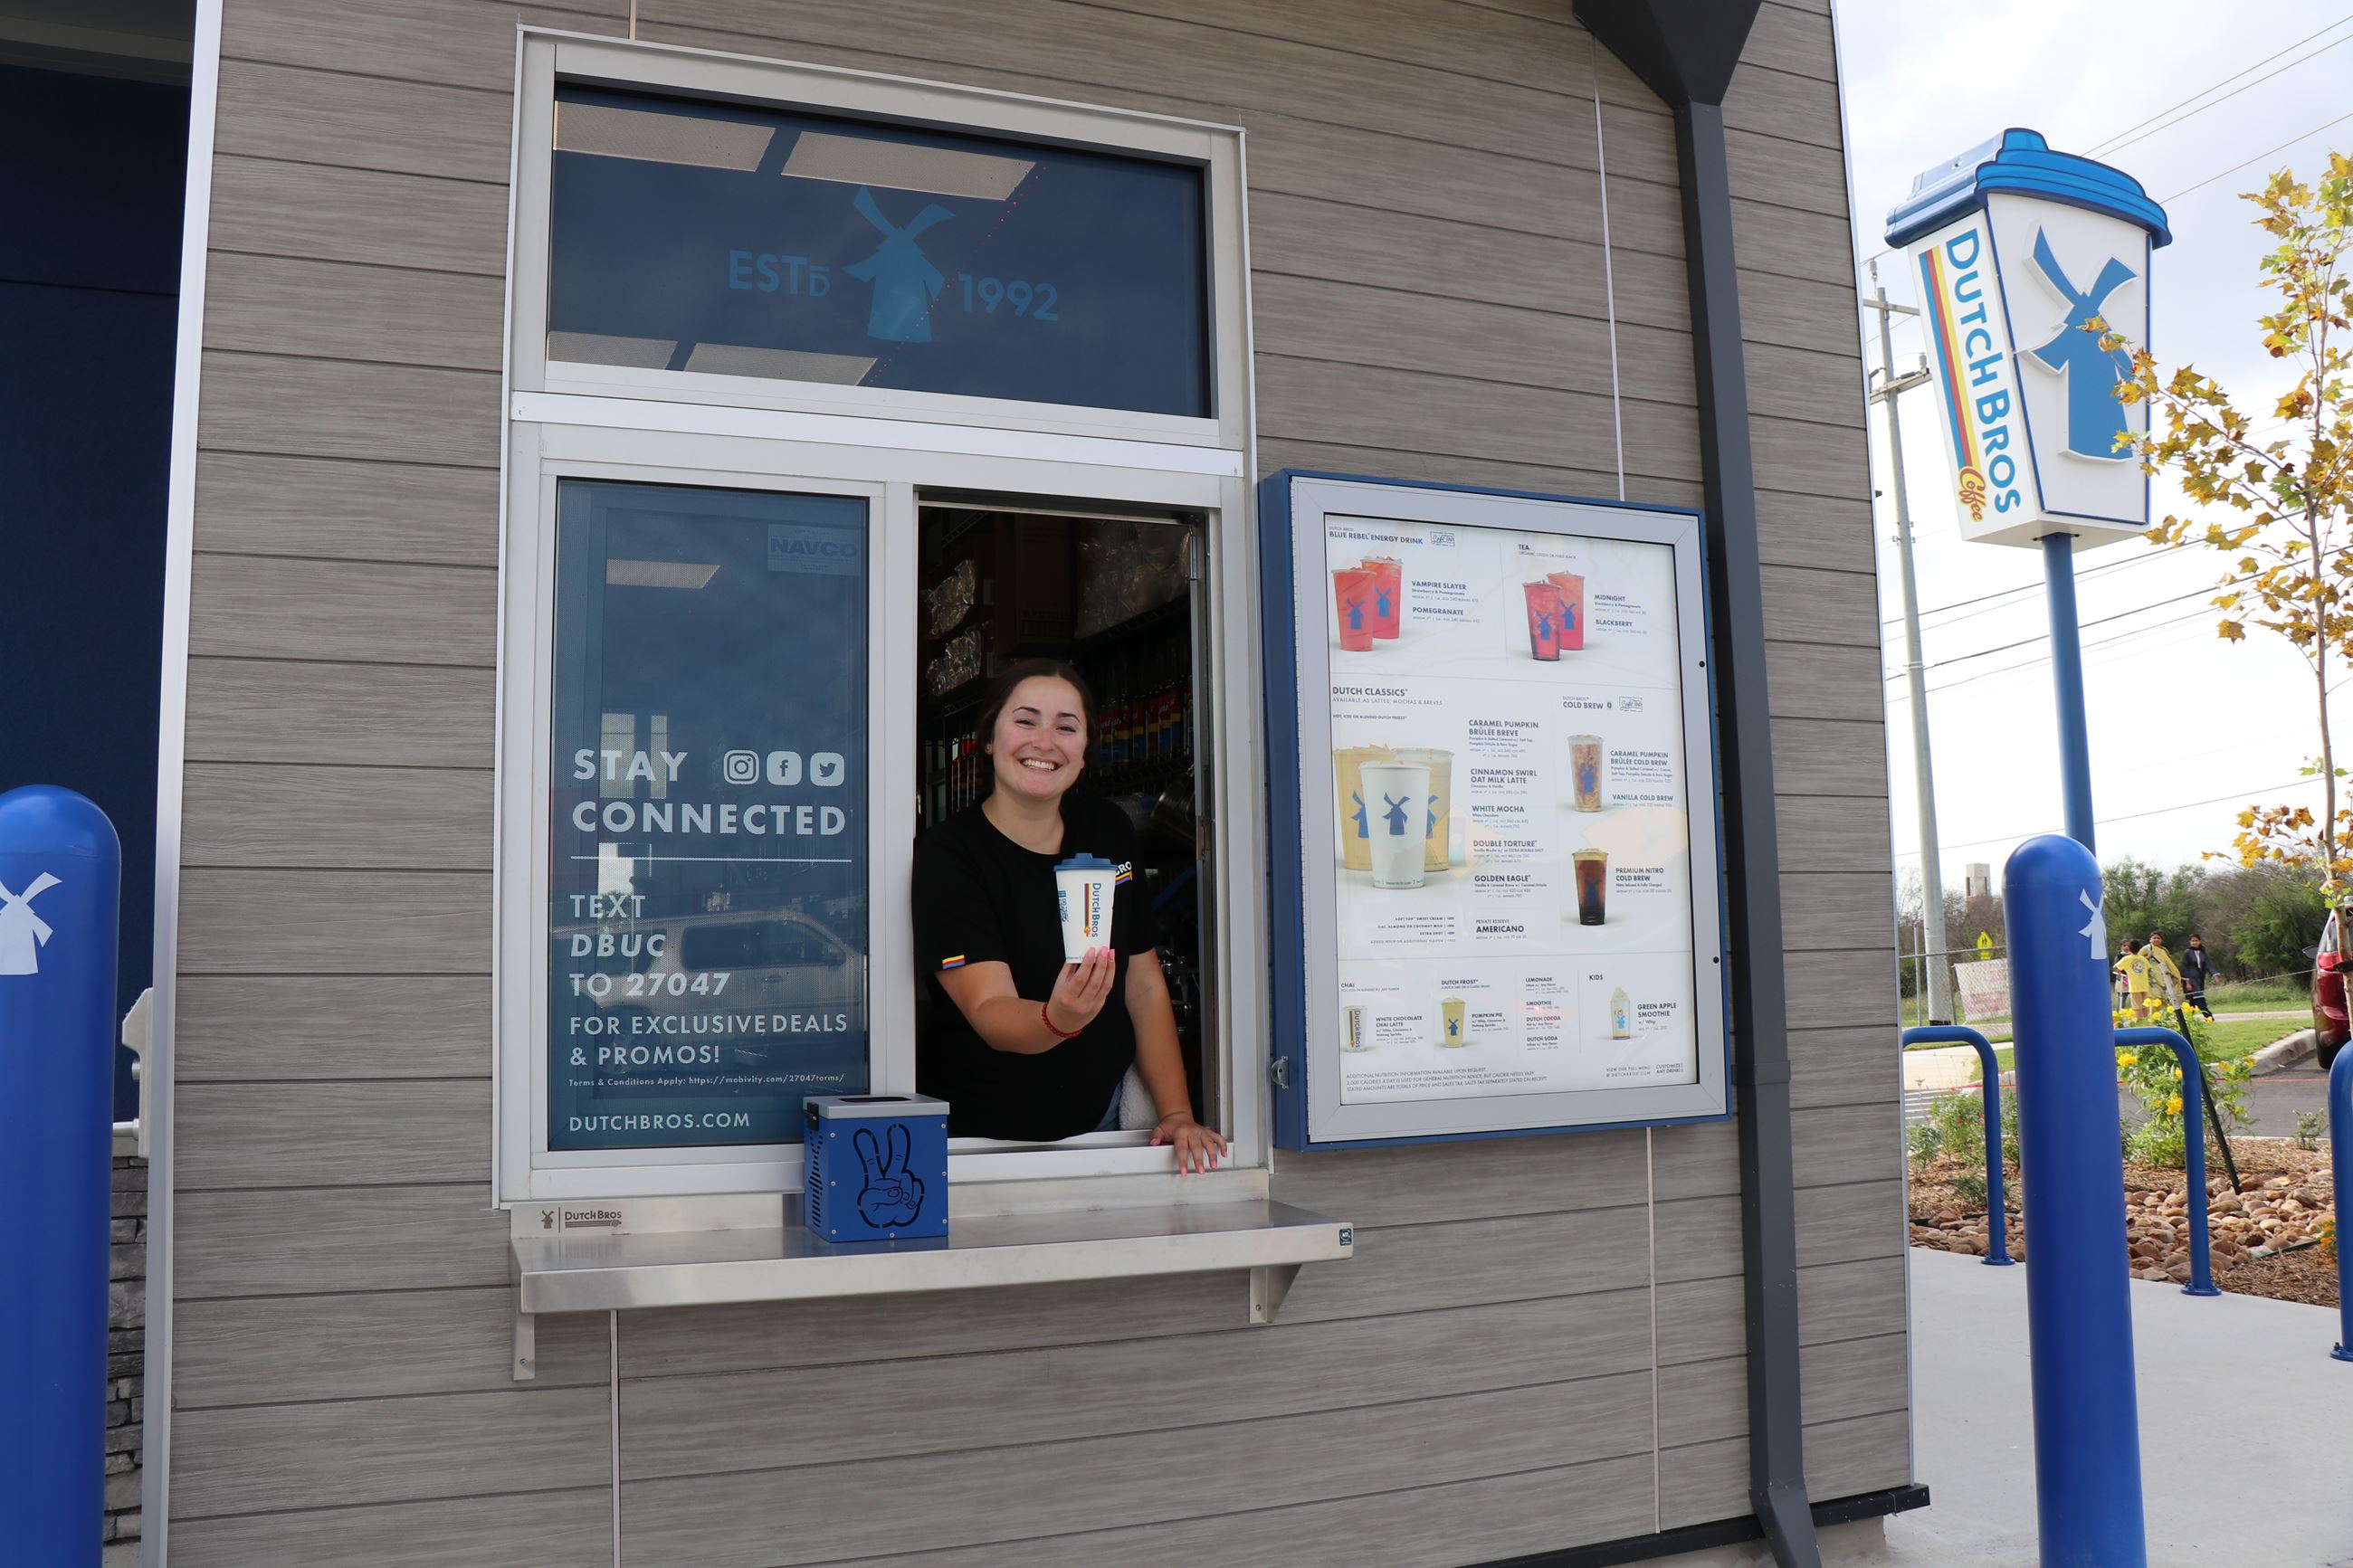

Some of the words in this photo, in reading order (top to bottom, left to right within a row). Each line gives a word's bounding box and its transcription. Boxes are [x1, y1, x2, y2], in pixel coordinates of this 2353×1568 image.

[958, 274, 1057, 321] 1992
[1958, 466, 1986, 522] Coffee
[770, 538, 858, 557] NAVCO
[1348, 532, 1368, 540] REBEL
[1371, 534, 1398, 543] ENERGY
[1400, 537, 1424, 545] DRINK
[1411, 580, 1442, 588] VAMPIRE
[1413, 606, 1463, 615] POMEGRANATE
[1596, 619, 1633, 627] BLACKBERRY
[1332, 687, 1362, 695] DUTCH
[1469, 719, 1502, 727] CARAMEL
[573, 749, 688, 781] STAY
[572, 802, 845, 835] CONNECTED
[570, 895, 646, 918] TEXT
[571, 934, 666, 957] DBUC
[569, 973, 612, 996] TO
[625, 973, 730, 996] 27047
[570, 1017, 620, 1035] FOR
[632, 1015, 766, 1034] EXCLUSIVE
[773, 1014, 847, 1032] DEALS
[570, 1048, 586, 1065] &
[598, 1046, 720, 1065] PROMOS!
[568, 1079, 595, 1087] Terms
[607, 1078, 654, 1086] Conditions
[657, 1078, 686, 1087] Apply:
[689, 1073, 844, 1086] https://mobivity.com/27047terms/
[569, 1113, 749, 1131] DUTCHBROS.COM
